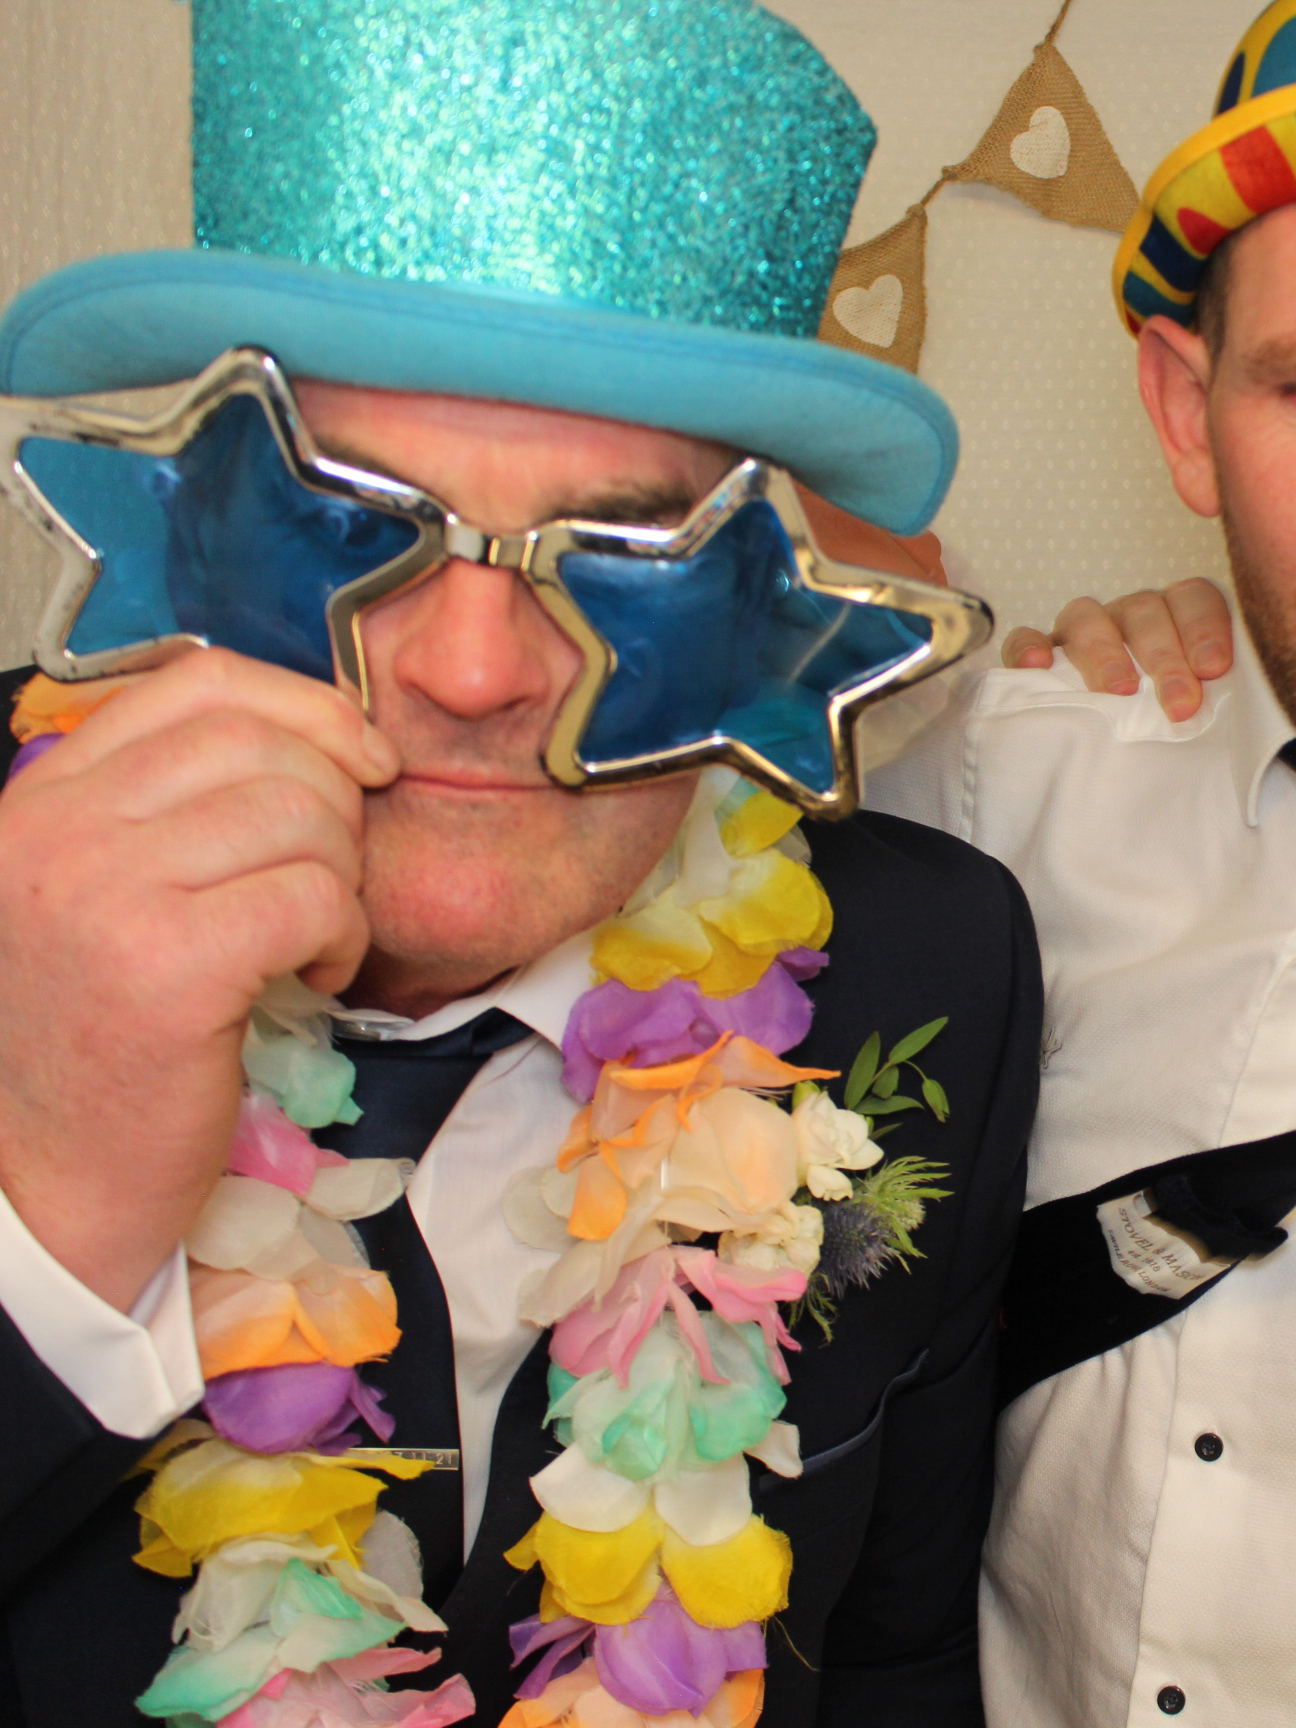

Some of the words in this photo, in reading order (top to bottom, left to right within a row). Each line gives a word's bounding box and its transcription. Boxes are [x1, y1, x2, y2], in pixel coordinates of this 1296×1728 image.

[1119, 1207, 1153, 1251] STOVEL
[1161, 1253, 1205, 1281] MASON
[1120, 1259, 1142, 1272] ROW
[1138, 1271, 1171, 1292] LONDON
